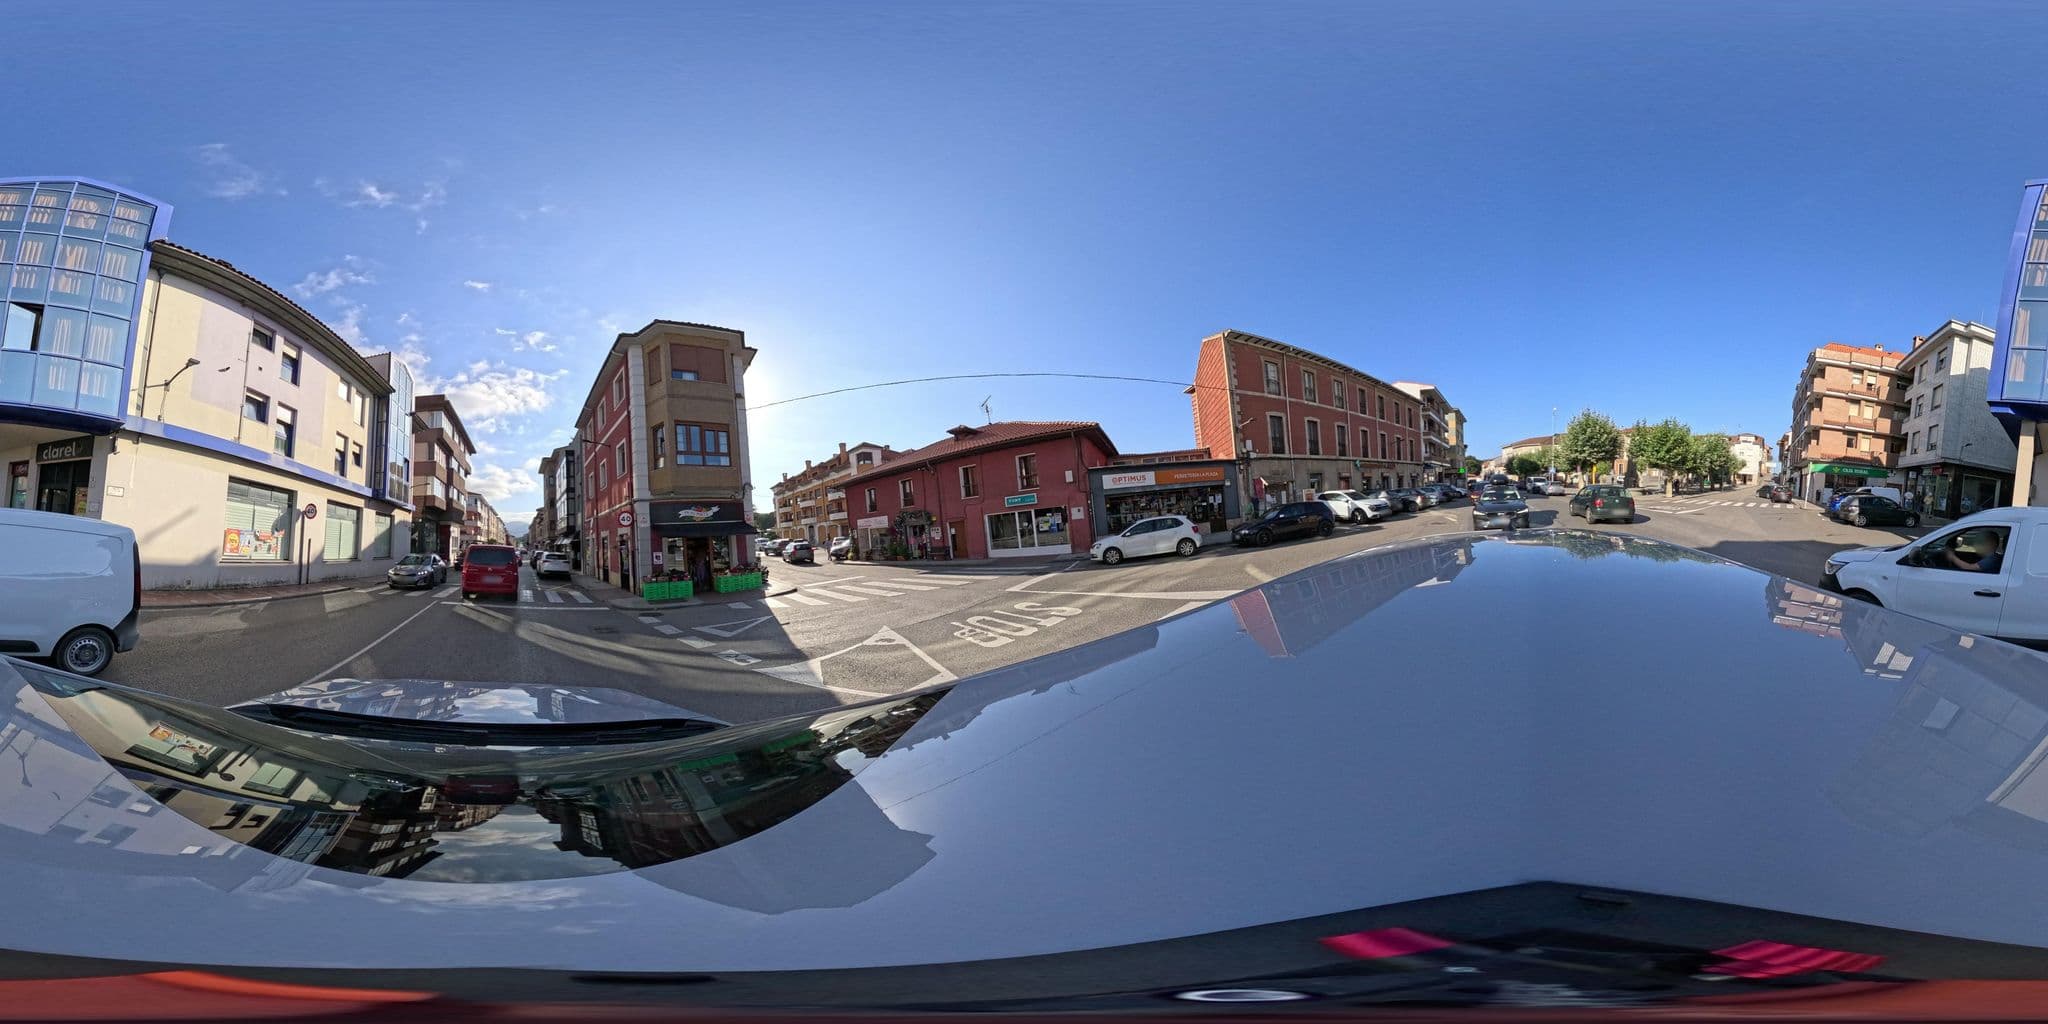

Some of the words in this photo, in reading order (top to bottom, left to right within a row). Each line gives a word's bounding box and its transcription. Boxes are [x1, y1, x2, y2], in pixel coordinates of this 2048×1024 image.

[42, 441, 77, 460] clarel
[1112, 474, 1147, 485] OPTIMUS
[950, 602, 1082, 648] STOP
